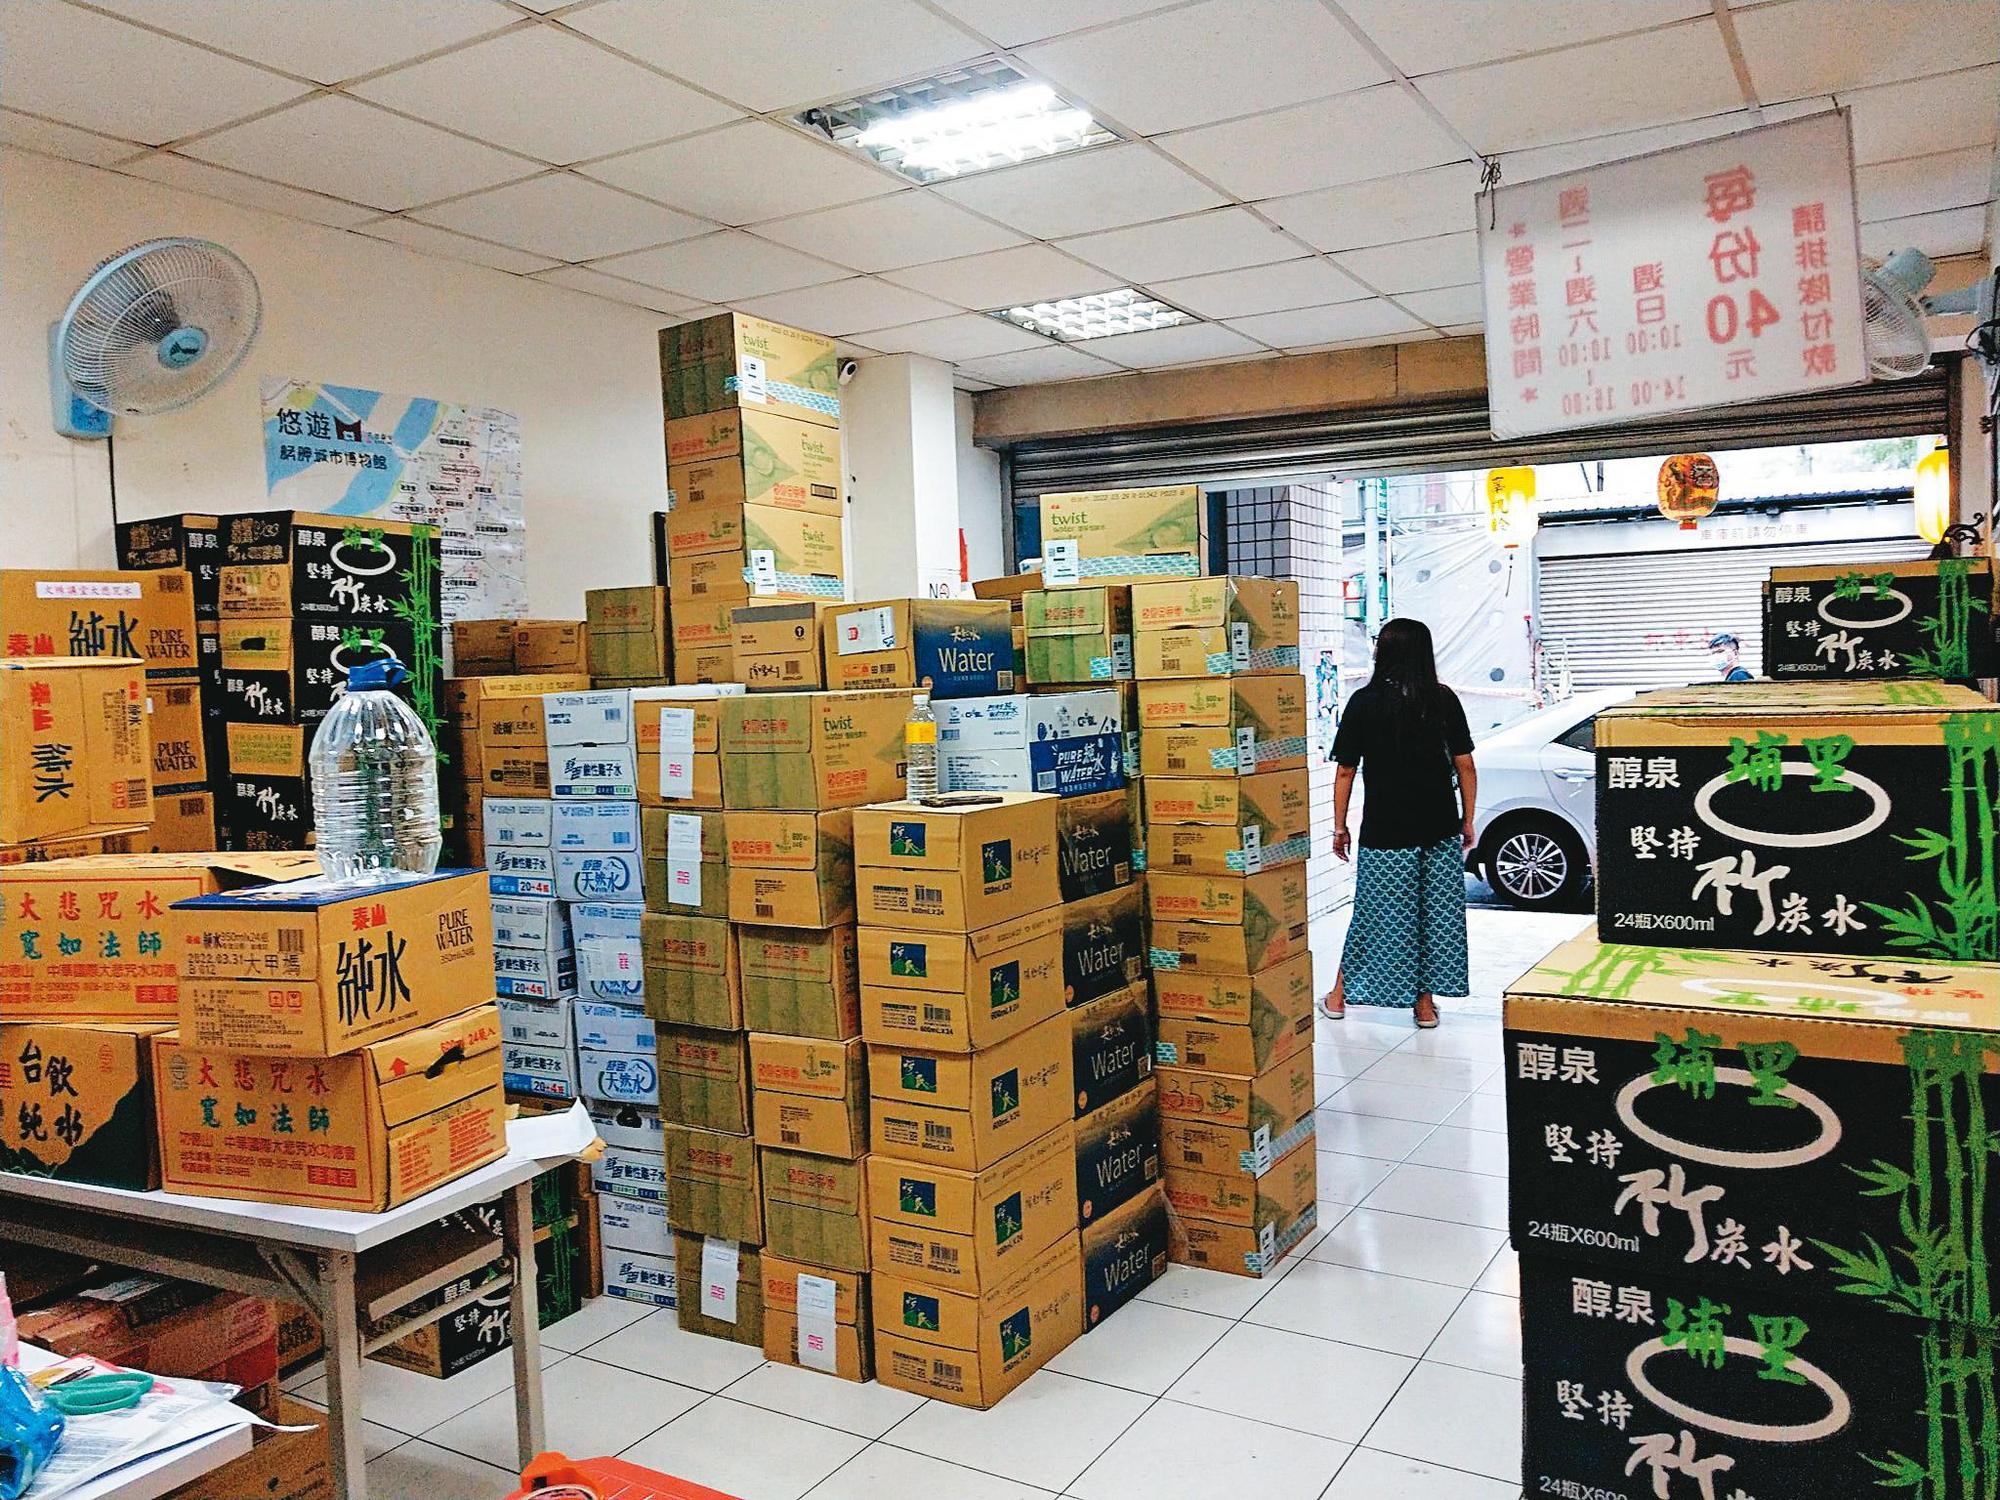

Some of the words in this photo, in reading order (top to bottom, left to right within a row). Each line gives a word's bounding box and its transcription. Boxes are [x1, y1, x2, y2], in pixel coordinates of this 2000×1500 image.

[742, 333, 769, 350] twist
[277, 407, 331, 440] 悠遊
[801, 439, 825, 454] twist
[1051, 512, 1088, 526] twist
[188, 532, 219, 548] 醇泉
[297, 529, 327, 547] 醇泉
[803, 527, 826, 544] twist
[200, 564, 219, 580] 堅
[306, 562, 335, 580] 堅持
[1775, 586, 1812, 604] 醇泉
[150, 629, 184, 644] PURE
[311, 625, 341, 642] 醇泉
[1786, 619, 1821, 638] 堅持
[145, 644, 191, 660] WATER
[938, 647, 995, 672] Water
[1814, 629, 1900, 673] 竹炭水
[306, 668, 334, 685] 堅持
[823, 715, 852, 732] twist
[154, 755, 198, 772] WATER
[157, 740, 190, 757] PURE
[1057, 749, 1083, 765] PURE
[1724, 730, 1857, 794] 埔里
[31, 742, 74, 804] 純水
[1060, 764, 1093, 784] WATER
[1607, 756, 1680, 791] 醇泉
[1630, 825, 1701, 861] 堅持
[1062, 845, 1112, 876] Water
[18, 890, 163, 921] 大悲咒水
[1691, 849, 1867, 937] 竹炭水
[352, 903, 388, 932] 泰山
[438, 908, 468, 932] PURE
[1614, 913, 1715, 932] 24瓶X600ml
[20, 929, 163, 960] 寬如法師
[435, 927, 475, 951] WATER
[1077, 941, 1125, 976] Water
[336, 930, 412, 1027] 純水
[198, 1055, 332, 1096] 大悲咒水
[1091, 1041, 1137, 1081] Water
[1517, 1041, 1600, 1085] 醇泉
[1650, 1025, 1800, 1110] 埔里
[200, 1095, 331, 1136] 寬如法師
[1544, 1123, 1624, 1170] 堅持
[1096, 1143, 1144, 1188] Water
[1614, 1164, 1815, 1276] 竹炭水
[1528, 1220, 1640, 1253] 24瓶X600ml
[1104, 1244, 1150, 1292] Water
[1571, 1276, 1655, 1326] 醇泉
[1660, 1297, 1810, 1386] 埔里
[1556, 1379, 1634, 1432] 堅持
